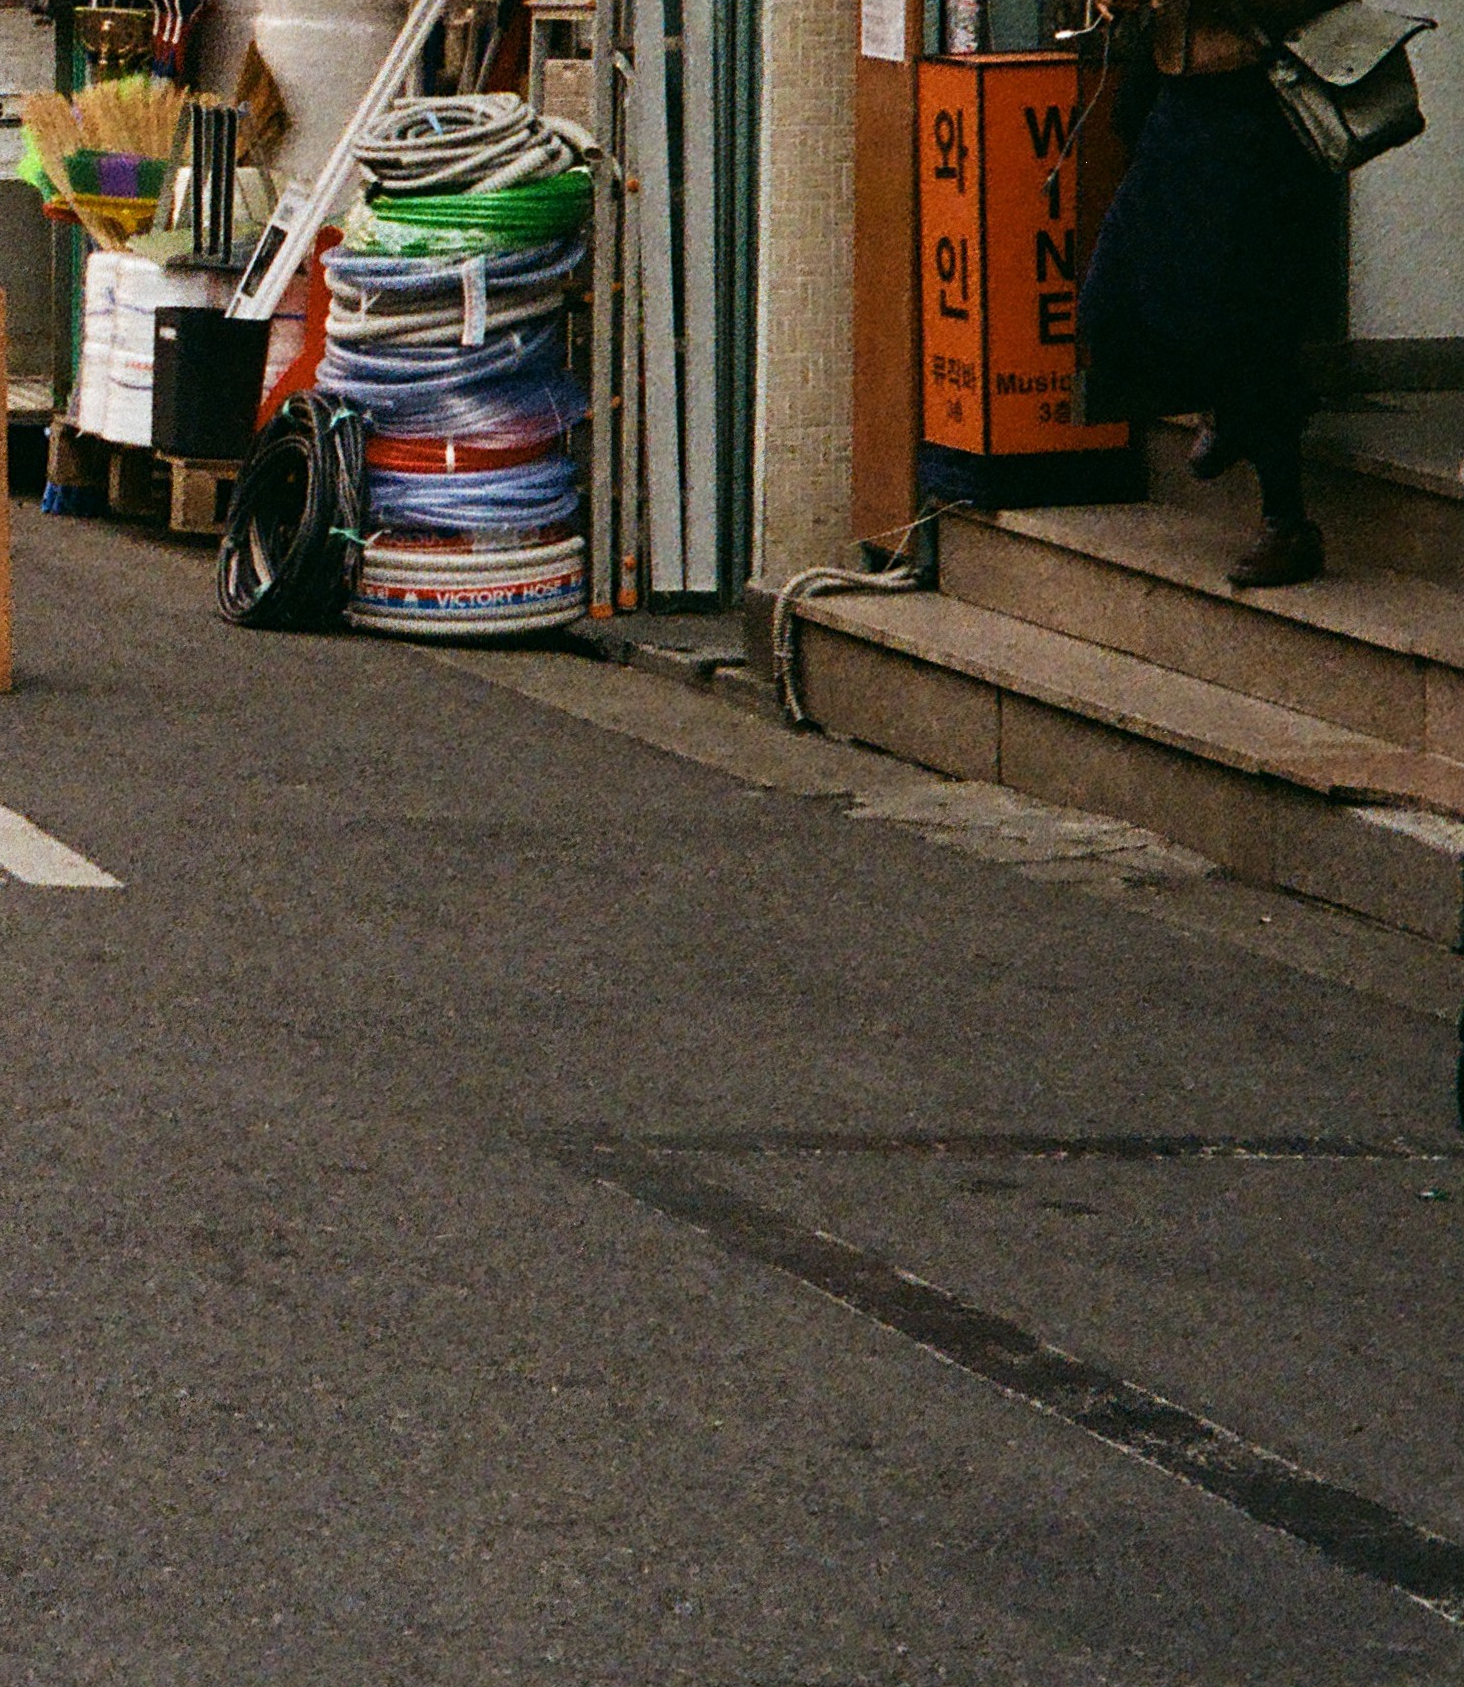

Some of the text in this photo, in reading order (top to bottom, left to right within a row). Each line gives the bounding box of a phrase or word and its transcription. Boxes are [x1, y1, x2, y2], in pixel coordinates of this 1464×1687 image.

[933, 108, 969, 321] 와인
[1025, 105, 1076, 346] WINE
[434, 587, 517, 609] VICTORY
